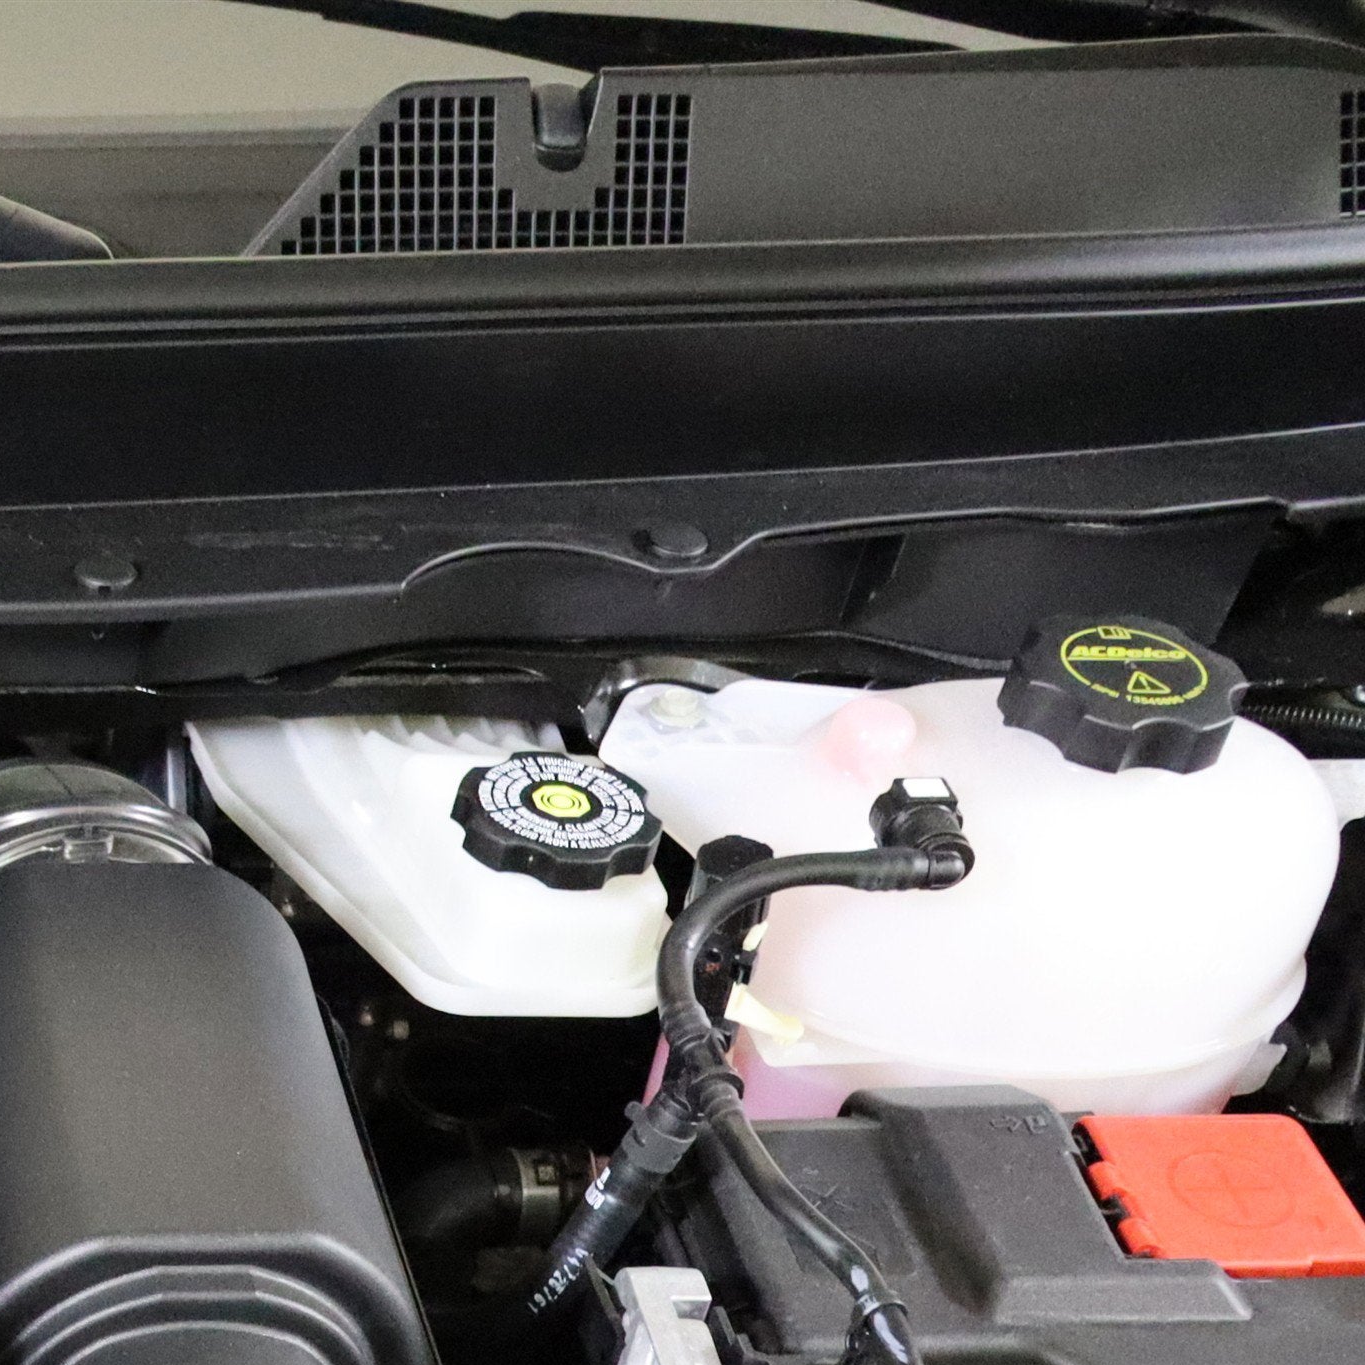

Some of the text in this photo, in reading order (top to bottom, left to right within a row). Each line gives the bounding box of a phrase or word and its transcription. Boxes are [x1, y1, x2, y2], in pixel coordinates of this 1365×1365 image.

[1067, 644, 1188, 662] ACDelco
[537, 757, 584, 770] BOUCHON
[539, 837, 568, 848] FROM
